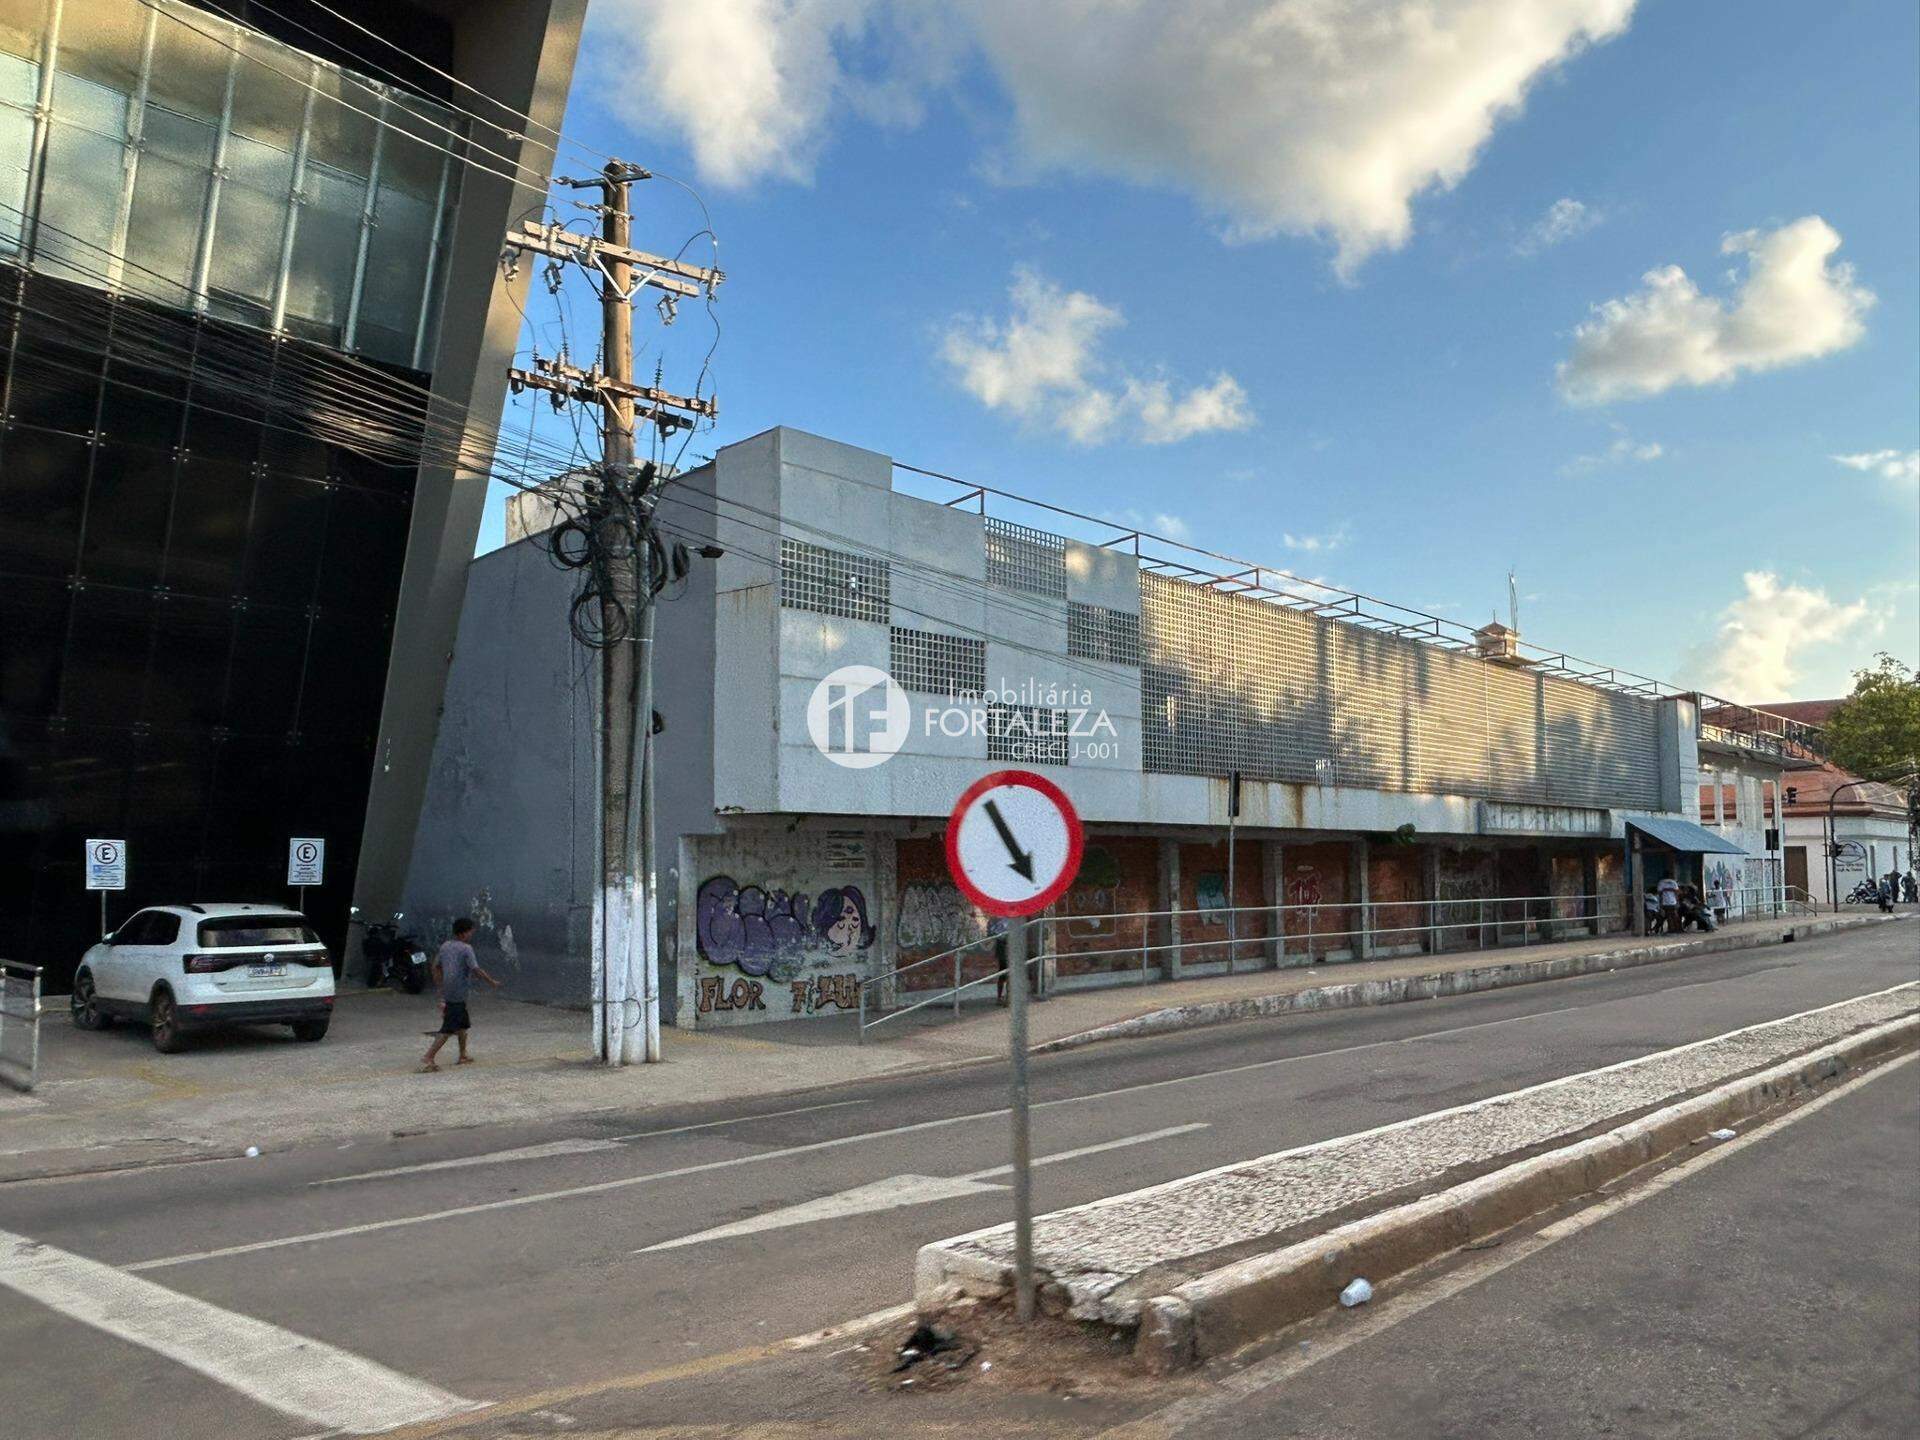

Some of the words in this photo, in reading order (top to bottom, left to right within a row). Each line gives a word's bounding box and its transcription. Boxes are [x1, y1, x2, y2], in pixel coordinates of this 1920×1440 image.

[101, 846, 112, 861] E
[302, 845, 312, 860] E
[699, 975, 767, 1013] FLOR
